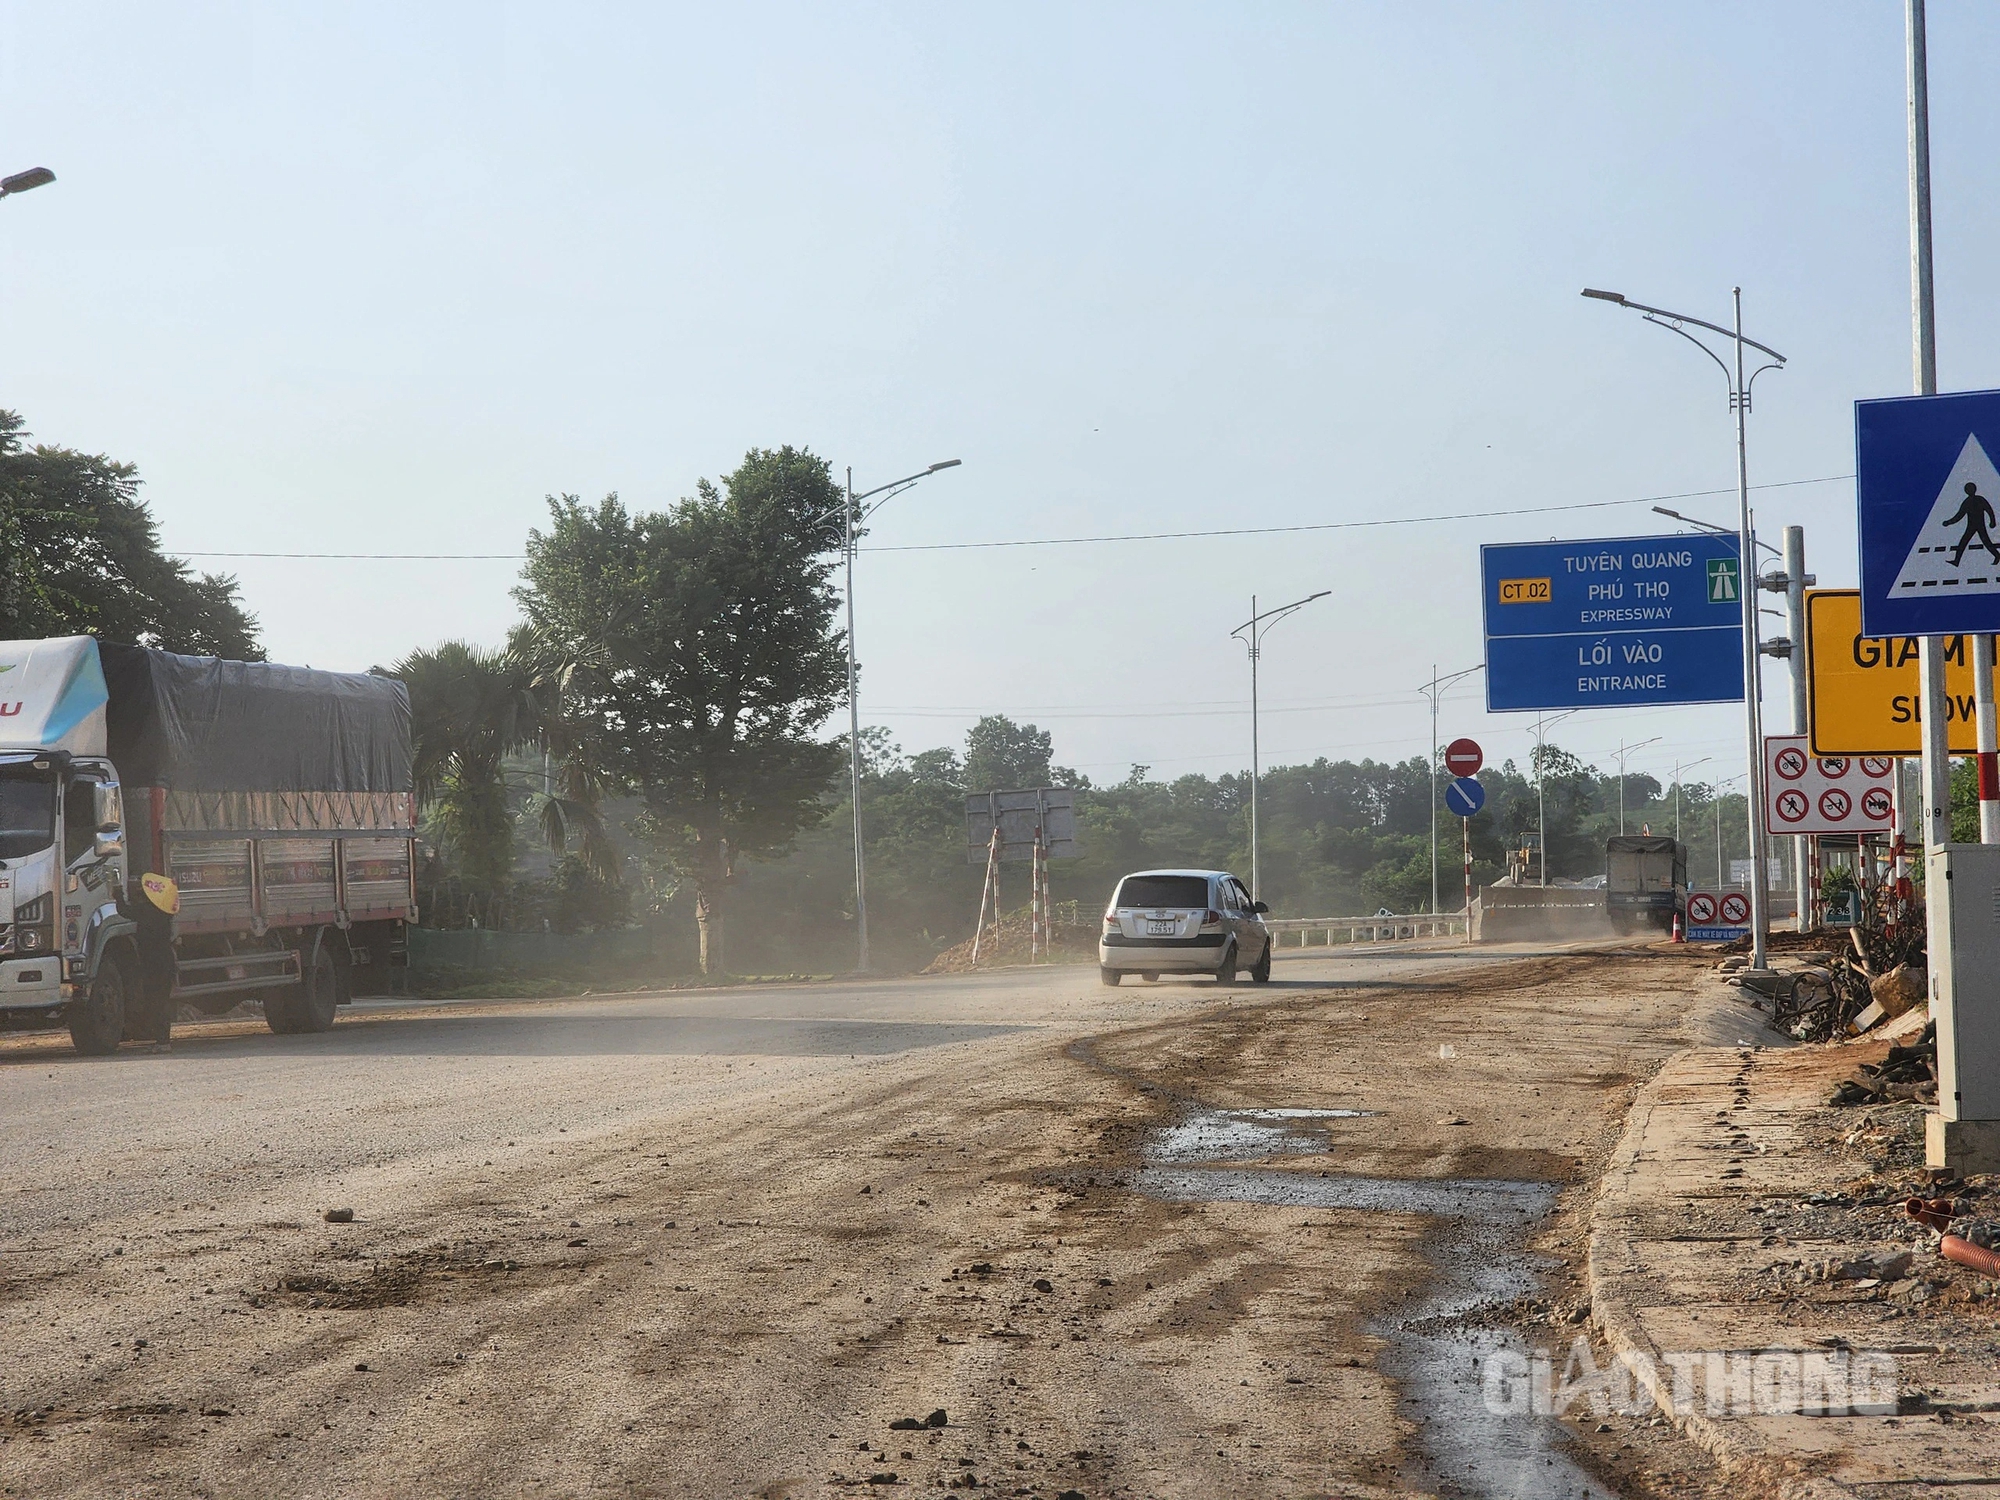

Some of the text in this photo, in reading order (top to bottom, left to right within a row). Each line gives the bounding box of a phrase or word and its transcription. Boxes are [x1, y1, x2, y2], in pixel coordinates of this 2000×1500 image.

[1564, 551, 1692, 573] TUYÊN QUANG
[1589, 578, 1670, 601] PHÚ THỌ
[1581, 607, 1673, 623] EXPRESSWAY
[1579, 638, 1662, 666] LỐI VÀO
[1578, 674, 1667, 692] ENTRANCE
